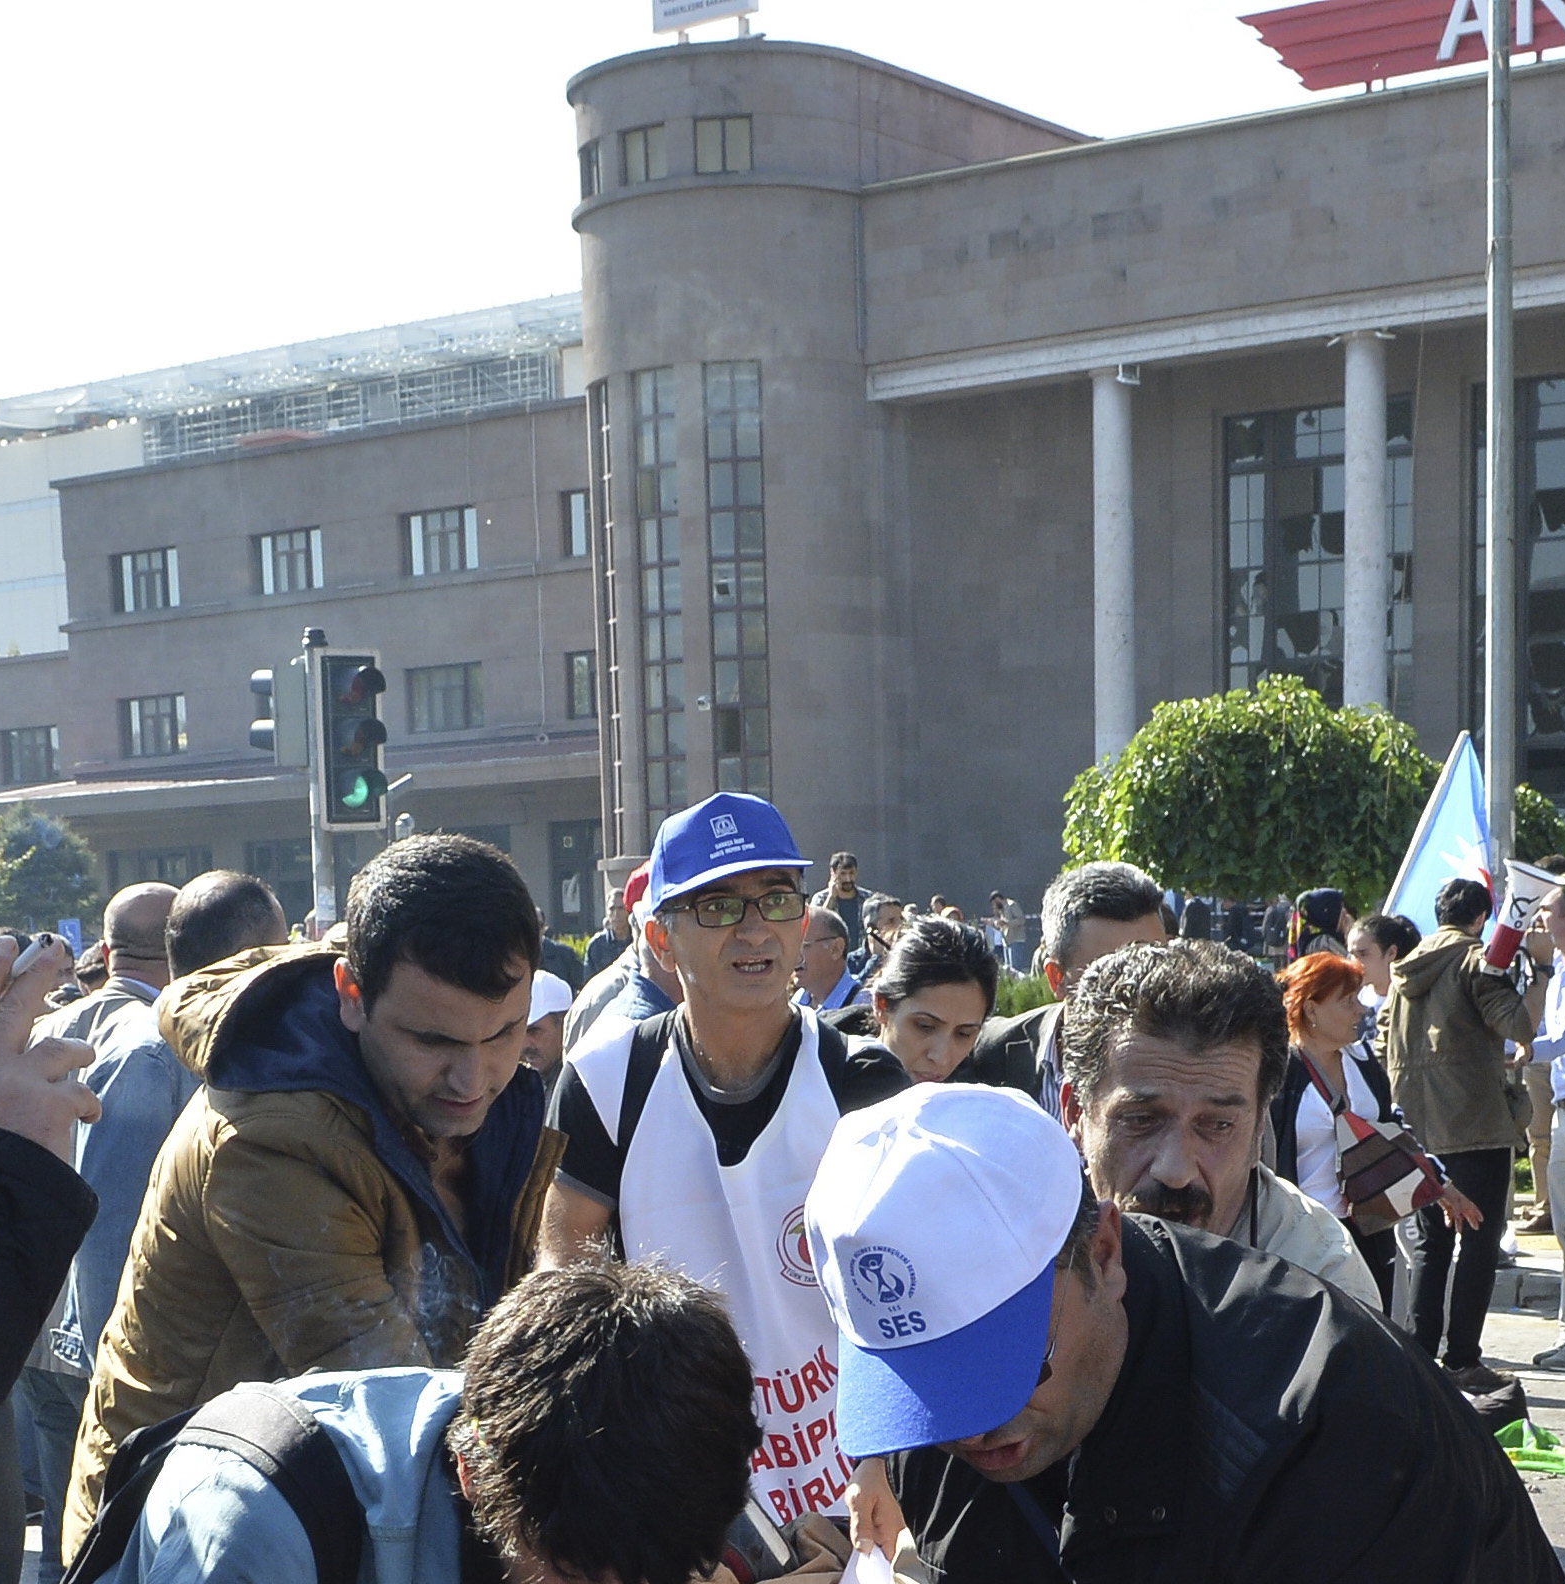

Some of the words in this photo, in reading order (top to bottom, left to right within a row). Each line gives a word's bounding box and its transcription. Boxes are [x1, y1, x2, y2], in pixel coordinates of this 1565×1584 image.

[878, 1310, 927, 1339] SES
[755, 1344, 839, 1415] TÜRK
[768, 1446, 855, 1524] BİRLİ
